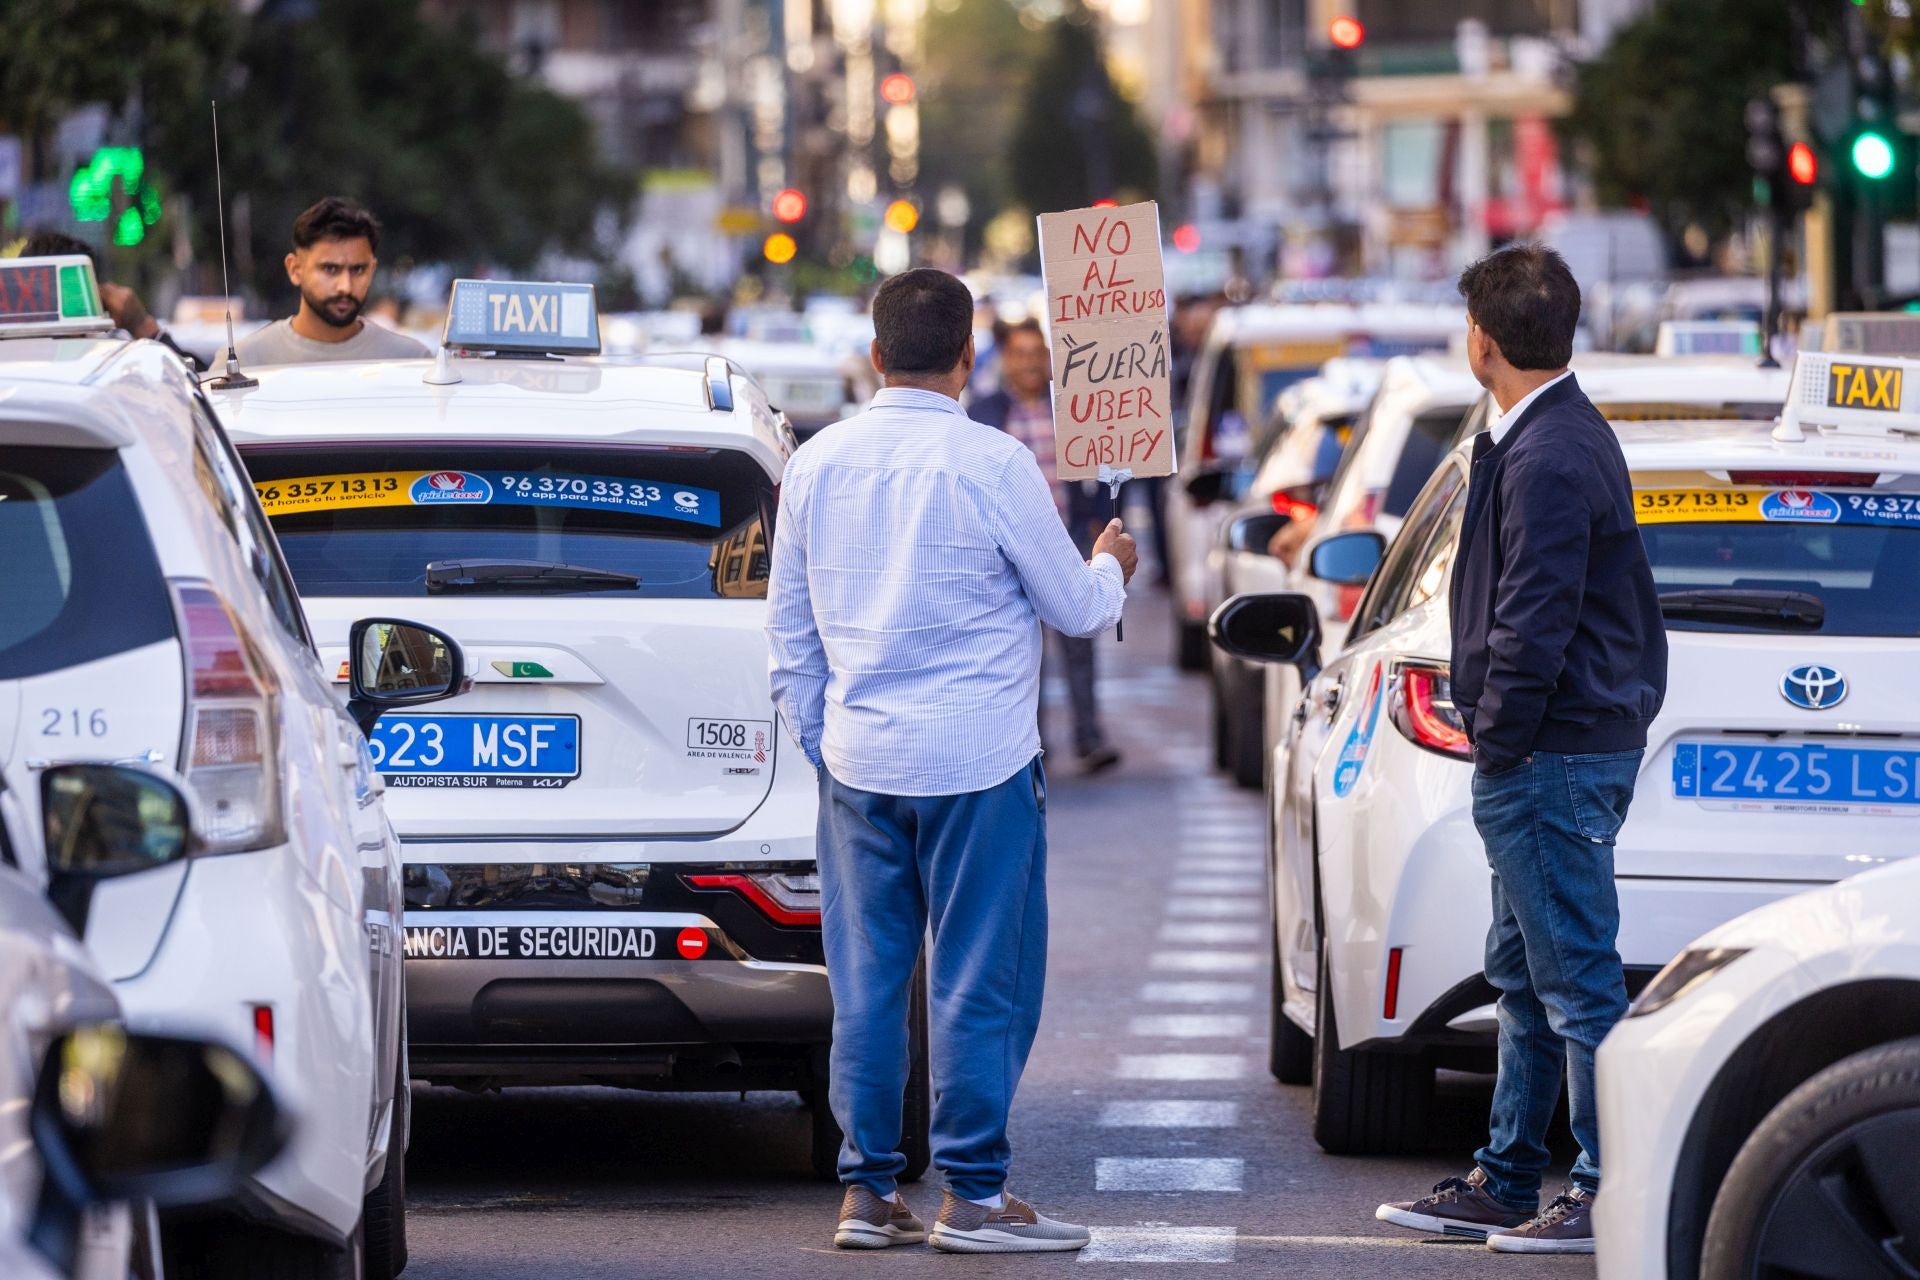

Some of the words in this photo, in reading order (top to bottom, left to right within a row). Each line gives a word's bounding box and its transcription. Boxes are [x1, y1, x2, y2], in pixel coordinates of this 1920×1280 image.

[1073, 217, 1131, 255] NO
[1083, 259, 1134, 291] AL
[489, 294, 558, 333] TAXI
[1055, 289, 1165, 322] INTRUSO
[1831, 365, 1902, 409] TAXI
[1070, 386, 1161, 423] UBER
[1065, 428, 1164, 467] CABIFY
[288, 481, 335, 497] 357
[340, 479, 366, 493] 13
[372, 477, 398, 491] 13
[340, 492, 386, 500] servicio
[501, 476, 532, 491] 96
[538, 477, 587, 494] 370
[592, 481, 624, 497] 33
[629, 484, 661, 501] 33
[532, 492, 557, 500] app
[560, 493, 588, 501] para
[592, 495, 623, 503] pedir
[626, 498, 648, 507] taxi
[1641, 494, 1687, 507] 357
[1692, 493, 1718, 506] 13
[1723, 493, 1749, 506] 13
[674, 505, 699, 515] COPE
[1848, 496, 1879, 511] 96
[1884, 498, 1920, 513] 37
[1862, 509, 1876, 517] Tu
[42, 708, 108, 738] 216
[696, 722, 745, 747] 1508
[473, 723, 556, 767] MSF
[393, 776, 460, 786] AUTOPISTA
[463, 777, 488, 787] SUR
[495, 777, 523, 786] Paterna
[1681, 775, 1691, 788] E
[1711, 750, 1832, 795] 2425
[478, 927, 509, 956] DE
[519, 927, 656, 957] SEGURIDAD
